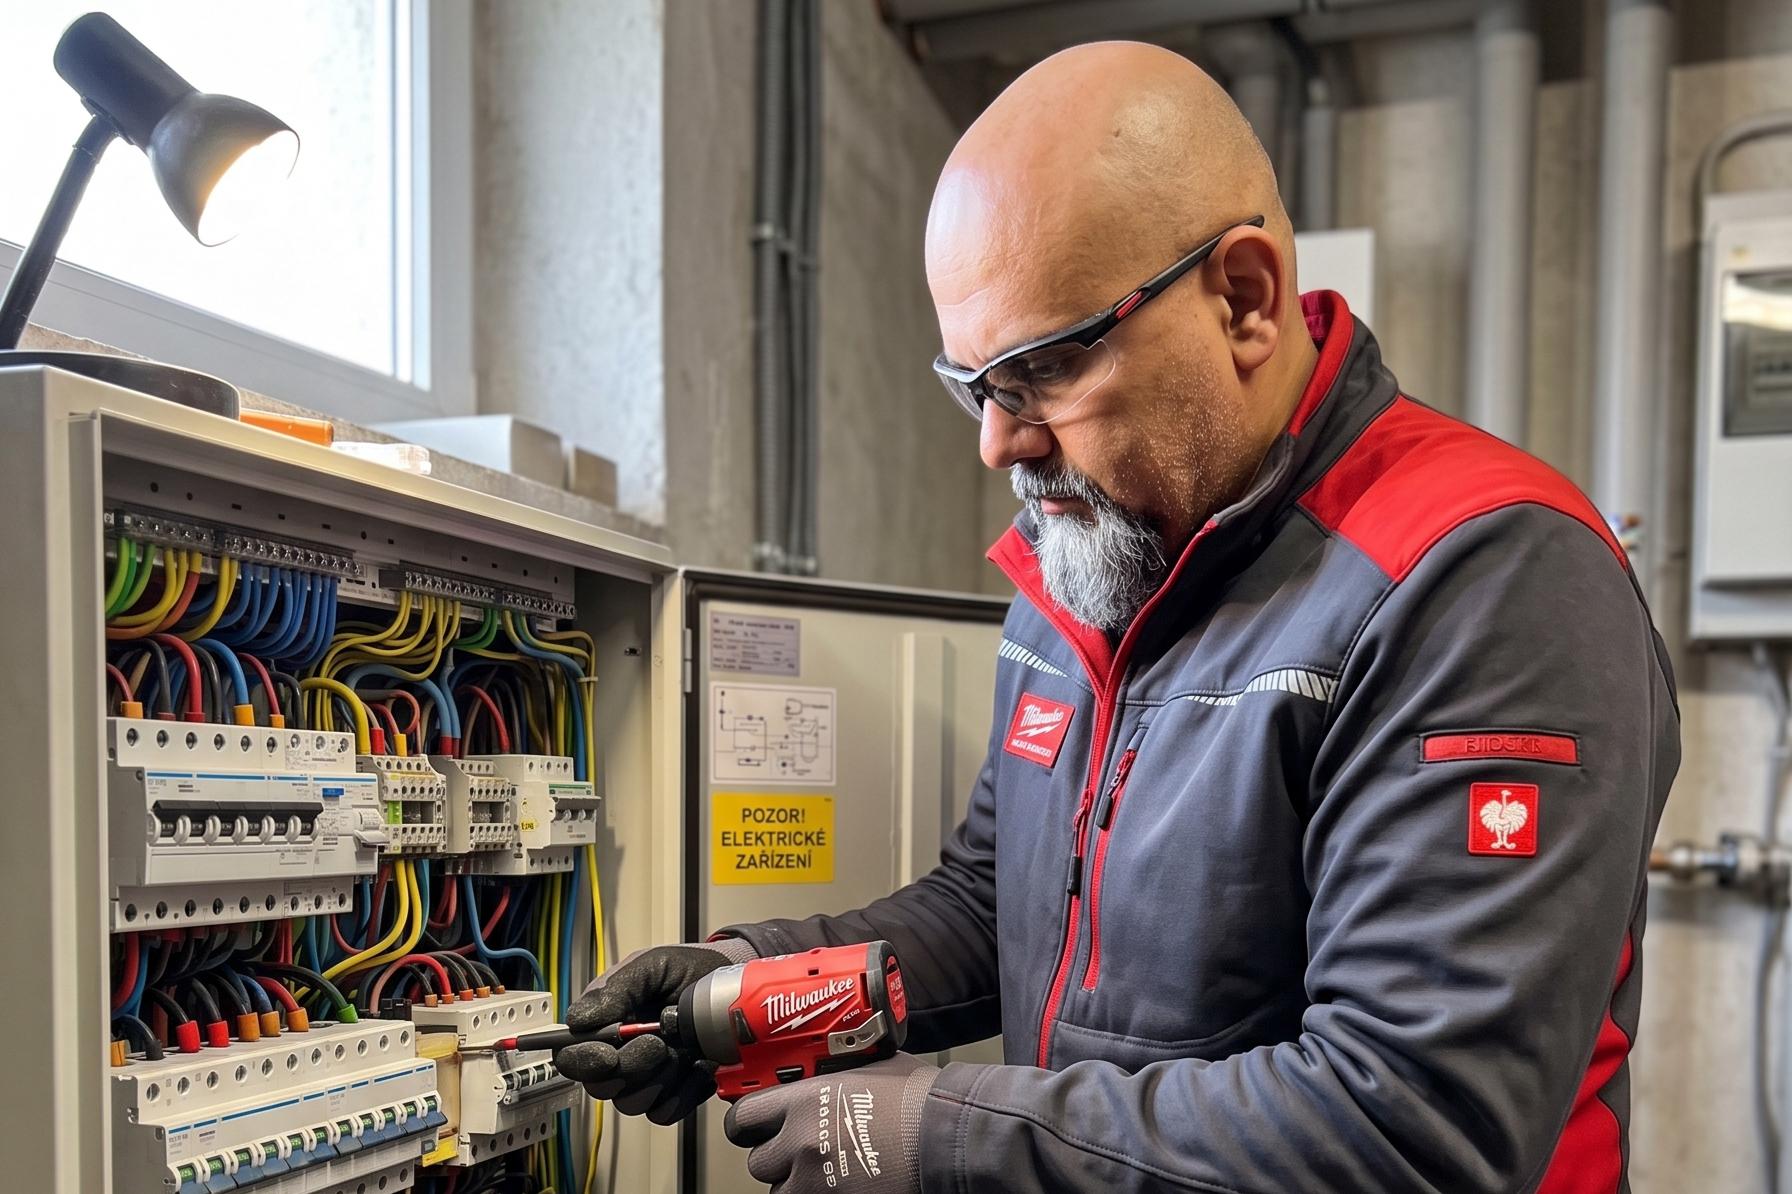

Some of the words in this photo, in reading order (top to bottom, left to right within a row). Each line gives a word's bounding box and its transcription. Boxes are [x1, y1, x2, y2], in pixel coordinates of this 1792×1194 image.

[742, 808, 806, 824] POZOR!
[721, 828, 826, 847] ELEKTRICKÉ
[735, 849, 812, 869] ZAŘÍZENÍ
[760, 977, 857, 1025] Milwaukee
[850, 1087, 881, 1177] Milwaukee
